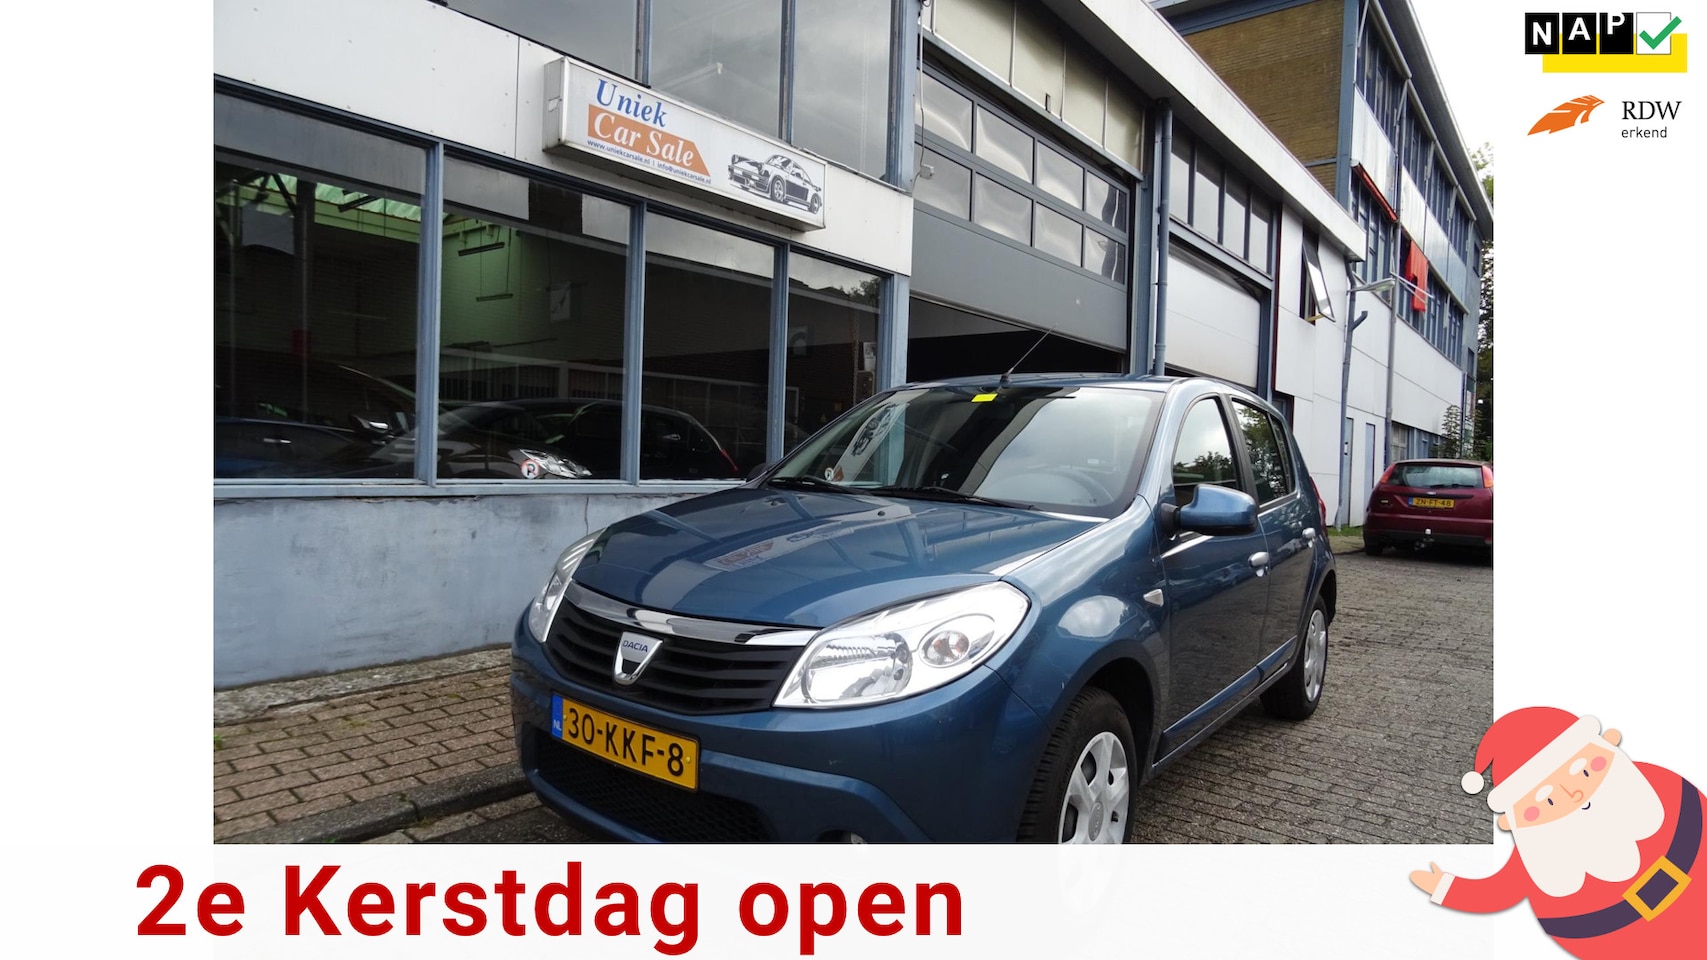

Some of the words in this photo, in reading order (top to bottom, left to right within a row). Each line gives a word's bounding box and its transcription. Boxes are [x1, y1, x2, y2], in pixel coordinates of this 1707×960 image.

[595, 78, 668, 128] Uniek
[587, 138, 651, 165] www.uniekcarsale.nl
[657, 162, 711, 185] info@uniekcarsale.nl
[594, 112, 641, 148] Car
[646, 129, 694, 167] Sale
[622, 639, 649, 653] DACIA
[553, 719, 562, 732] NL
[568, 708, 684, 777] 30-KKF-8
